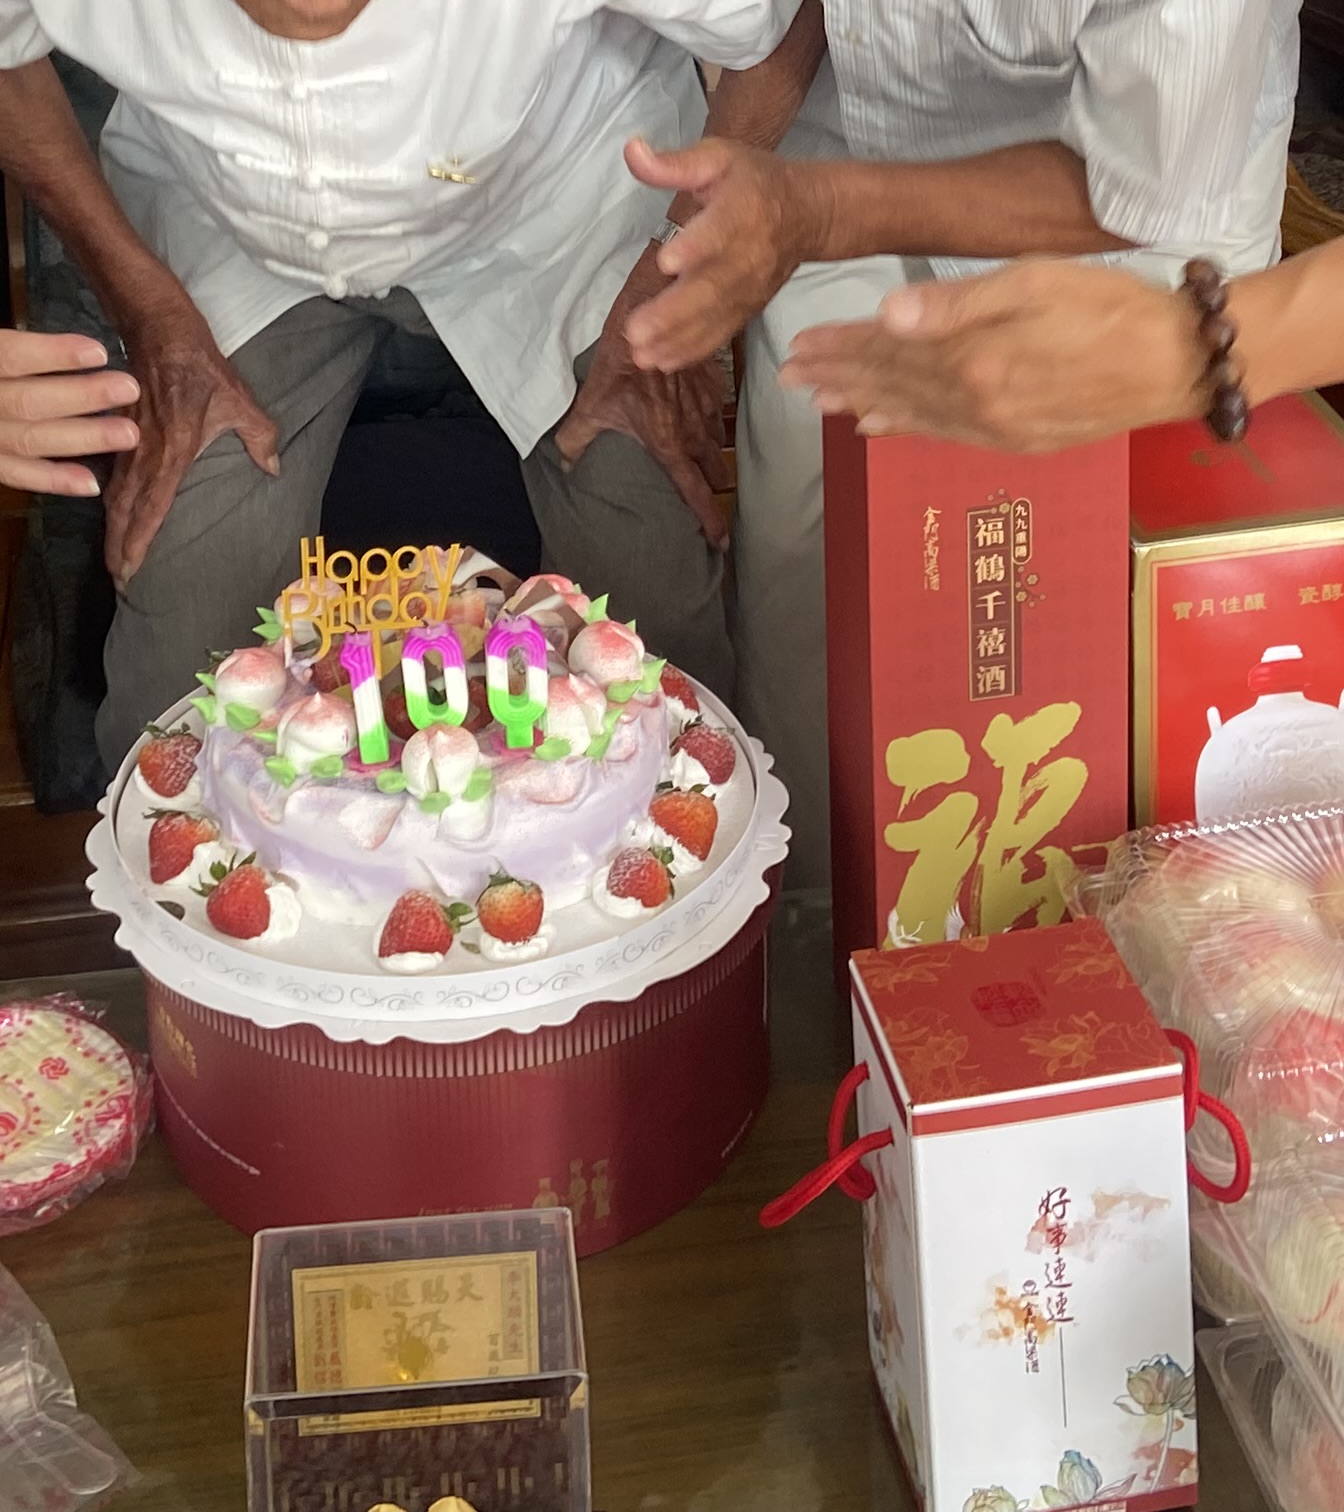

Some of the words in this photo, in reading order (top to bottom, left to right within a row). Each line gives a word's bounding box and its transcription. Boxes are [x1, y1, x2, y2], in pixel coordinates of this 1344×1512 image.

[300, 535, 460, 622] Happy
[974, 517, 1007, 695] 福鶴千禧酒
[339, 615, 549, 765] 100
[1037, 1186, 1075, 1323] 好事連連
